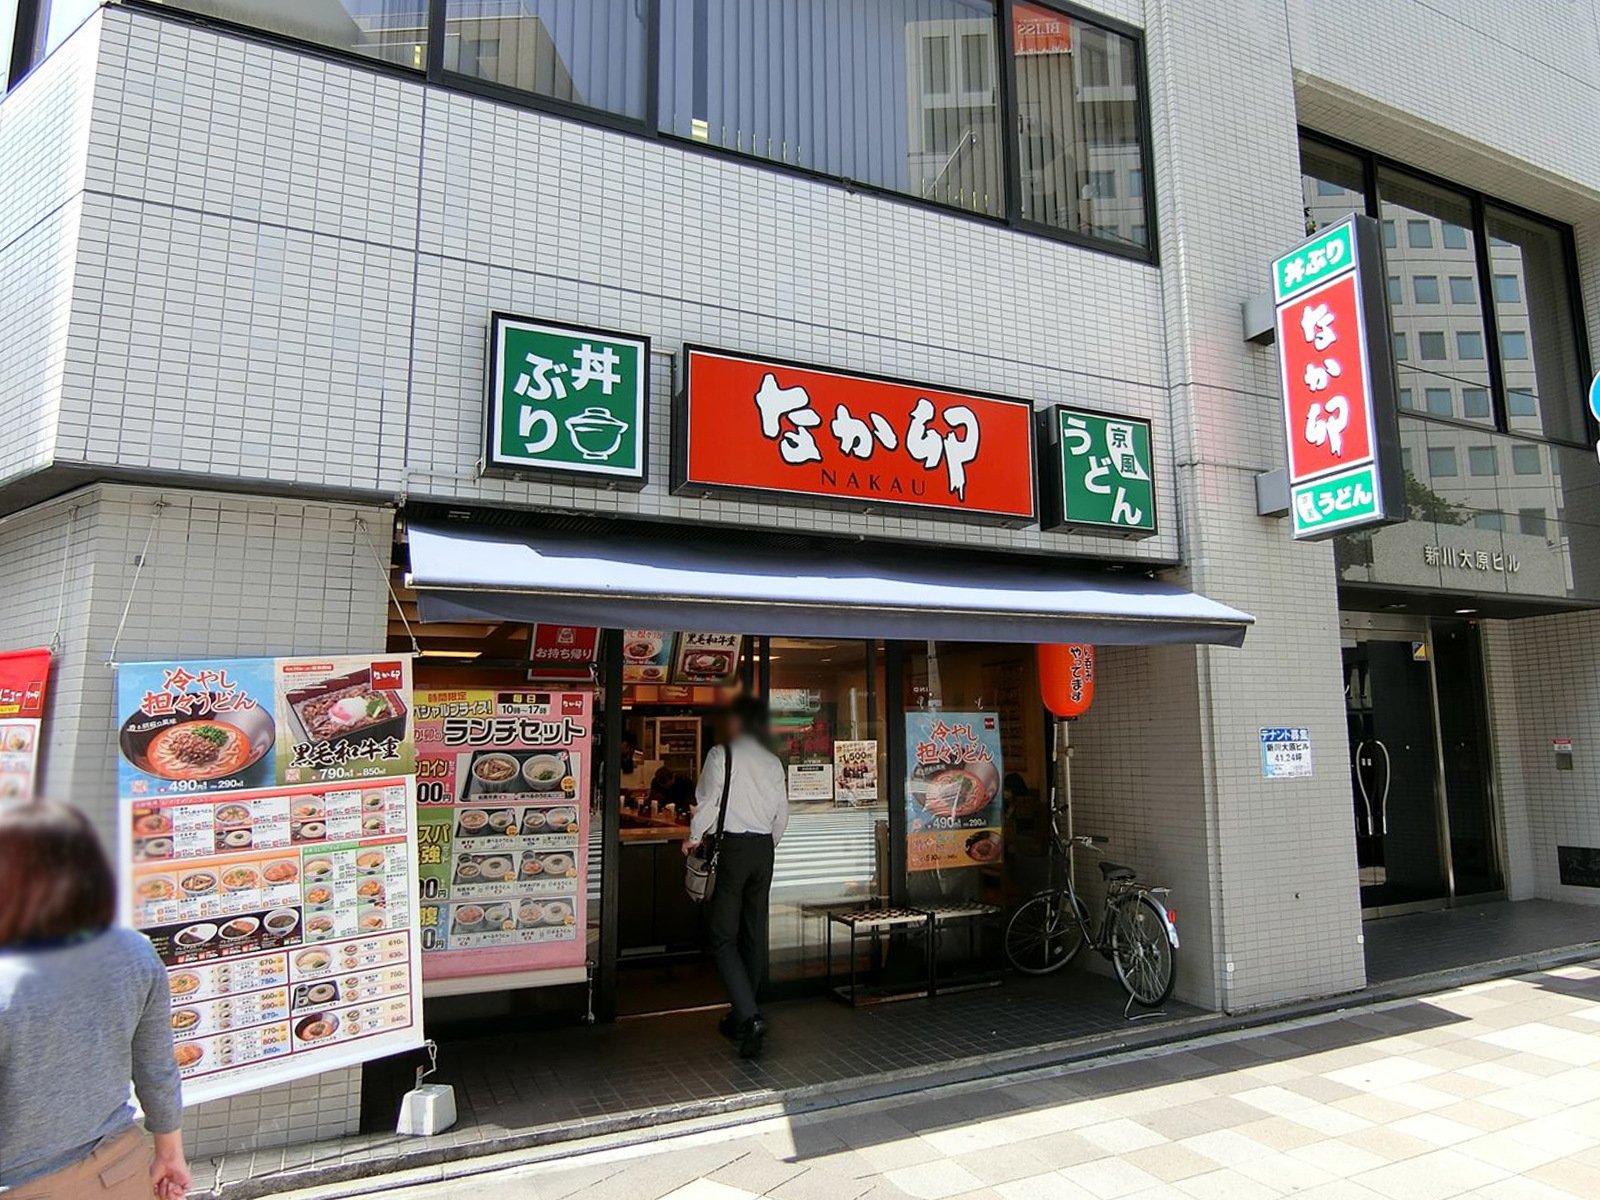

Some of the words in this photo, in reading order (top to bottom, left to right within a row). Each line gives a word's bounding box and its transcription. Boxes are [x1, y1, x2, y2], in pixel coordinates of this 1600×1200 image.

[1284, 238, 1345, 288] 丼ぶり
[1301, 303, 1350, 457] なか卯
[755, 373, 980, 502] なか卯
[1110, 426, 1138, 475] 京風
[820, 468, 927, 497] NAKAU
[1064, 416, 1142, 525] うどん
[1318, 483, 1373, 516] うどん
[1424, 545, 1521, 573] 新川大原ビル
[535, 646, 593, 660] お持ち帰り
[163, 667, 236, 691] 冷やし
[1069, 647, 1083, 703] やってます
[141, 690, 257, 715] 担々うどん
[428, 692, 467, 703] 時間限定
[444, 717, 587, 746] ランチセット
[930, 720, 978, 741] 冷やし
[290, 739, 400, 768] 黒毛和牛重
[916, 742, 994, 764] 担々うどん
